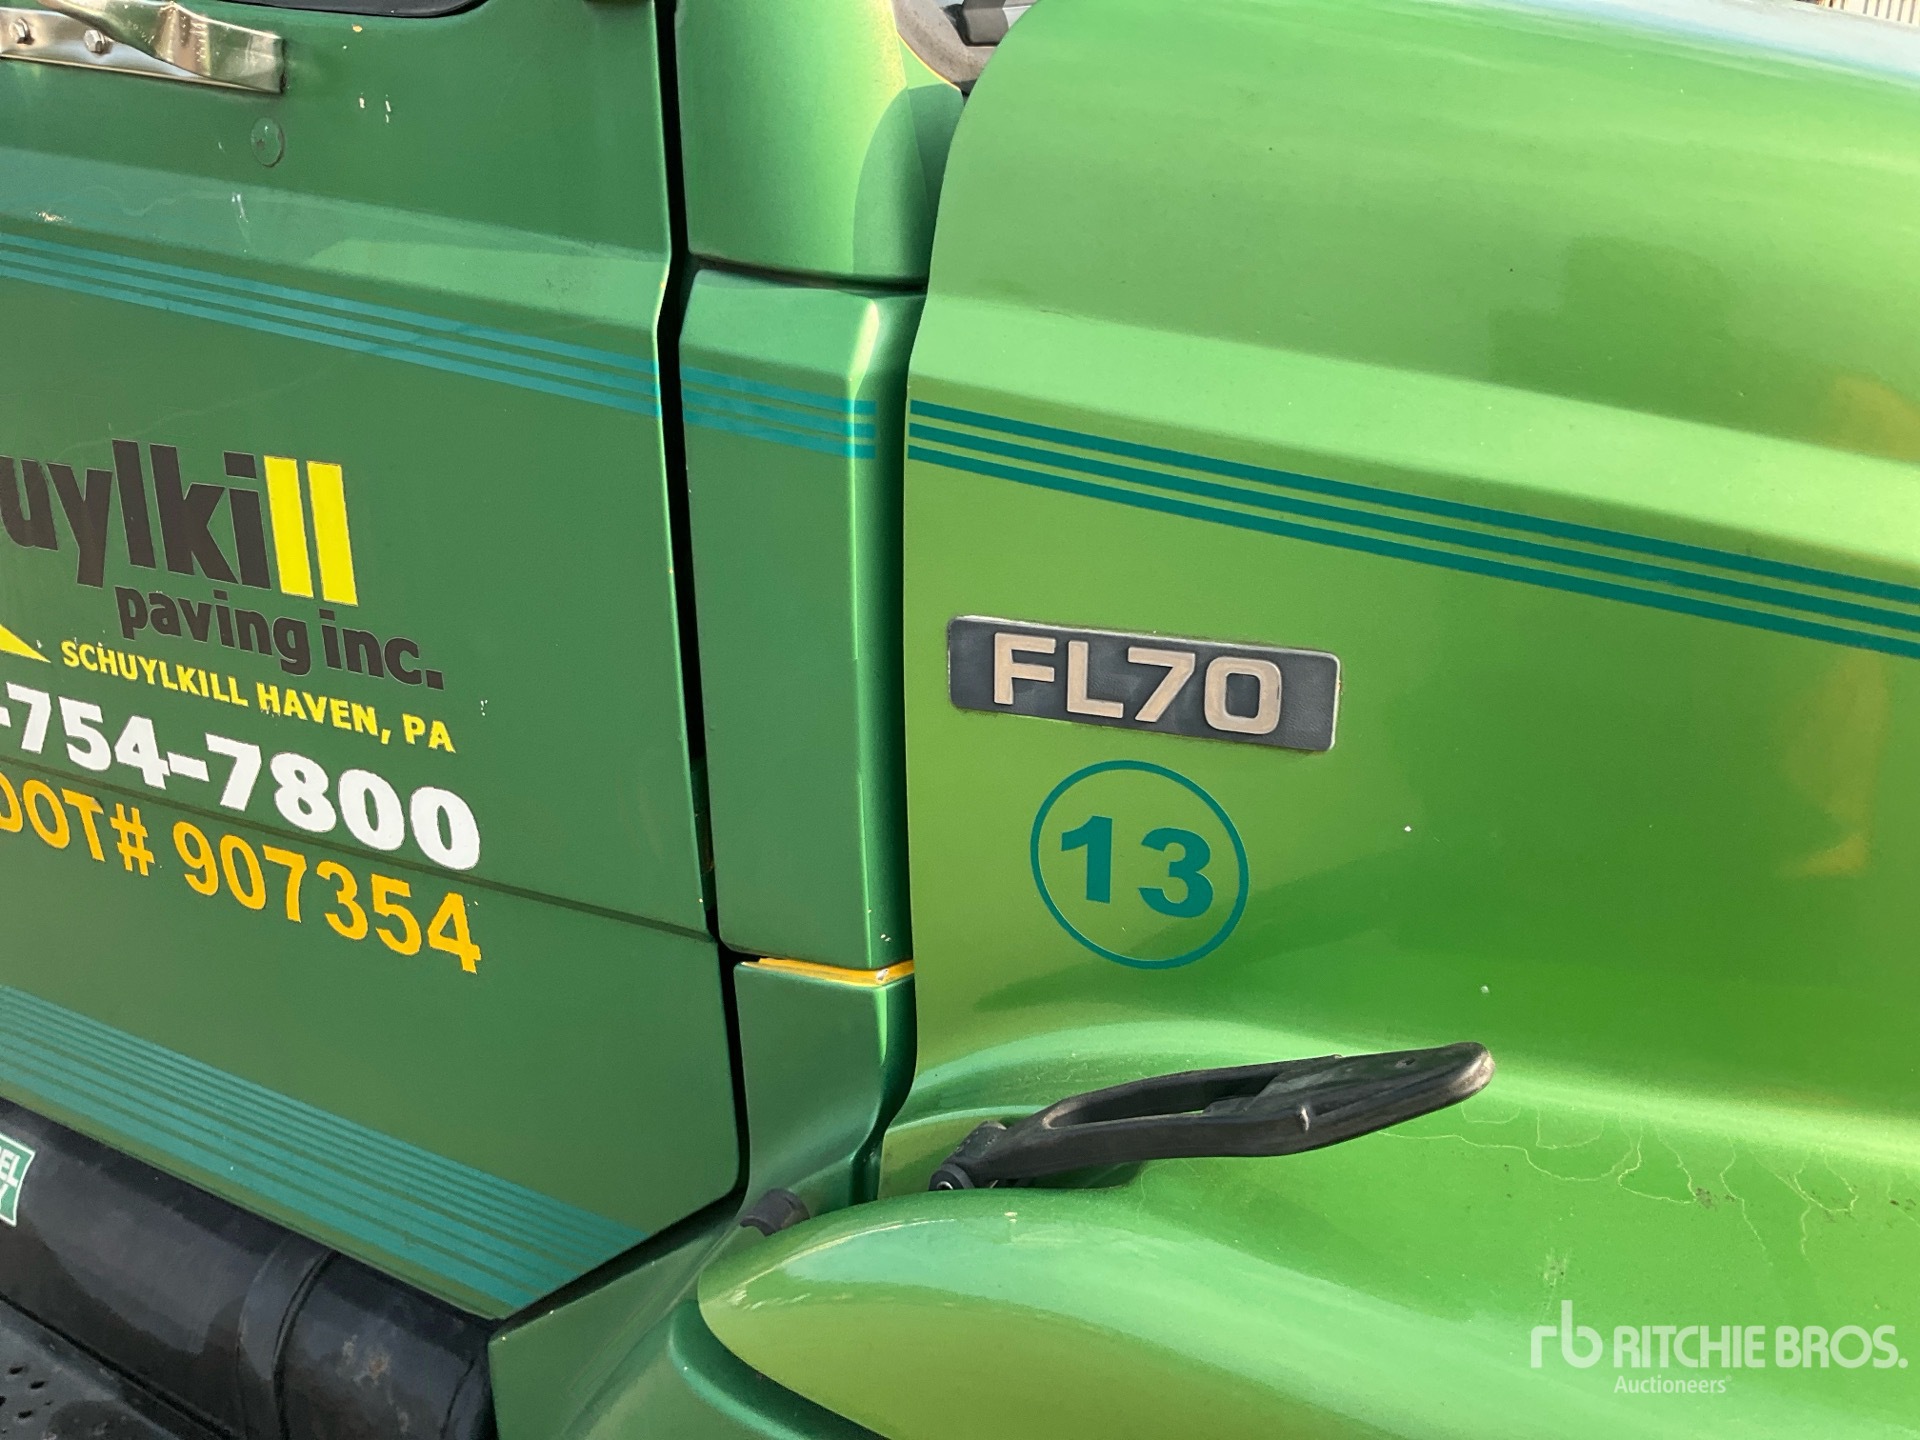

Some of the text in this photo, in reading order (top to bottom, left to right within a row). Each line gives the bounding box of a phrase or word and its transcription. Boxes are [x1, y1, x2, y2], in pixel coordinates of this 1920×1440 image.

[115, 587, 444, 690] paving inc.
[994, 633, 1281, 735] FL70
[61, 641, 456, 754] SCHUYLKILL HAVEN, PA
[173, 820, 482, 974] 907354
[1061, 815, 1214, 918] 13
